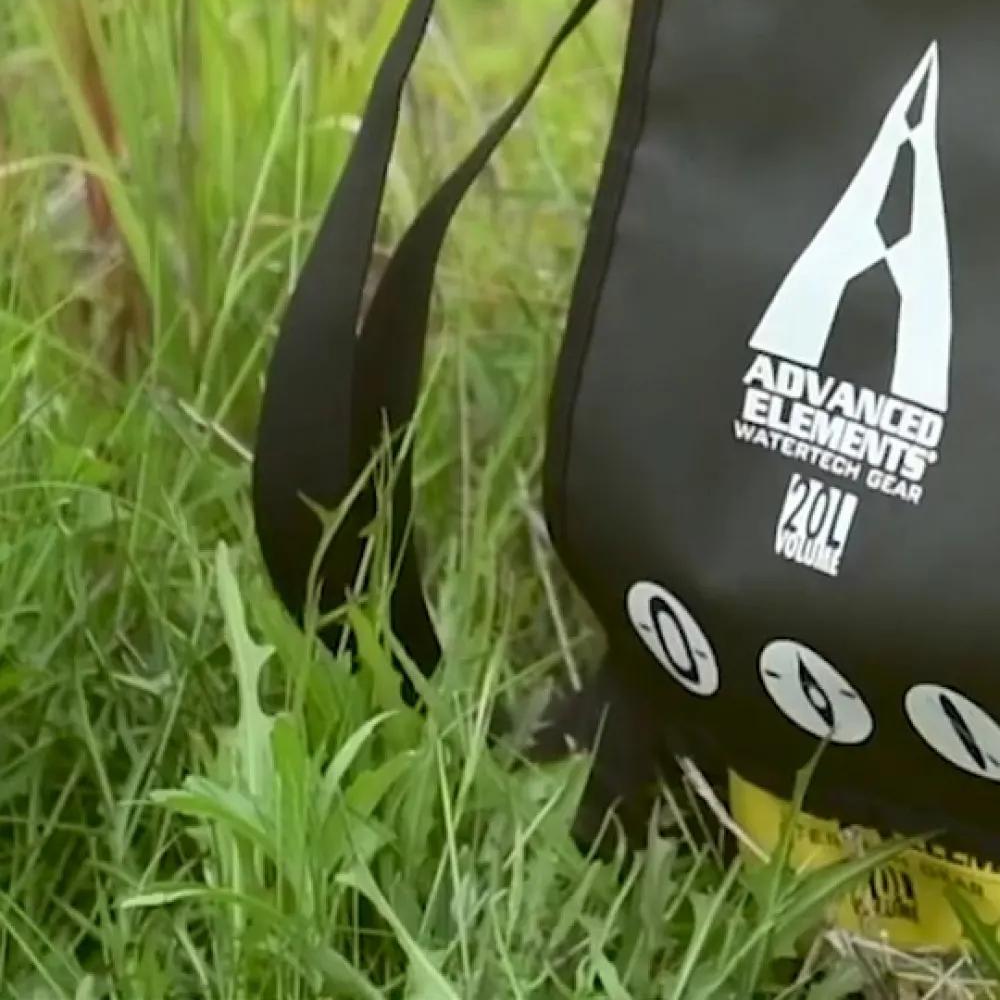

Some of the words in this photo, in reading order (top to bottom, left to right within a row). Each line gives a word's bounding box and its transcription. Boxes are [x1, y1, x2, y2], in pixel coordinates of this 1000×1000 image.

[742, 353, 945, 448] ADVANCED
[743, 387, 927, 482] ELEMENTS
[733, 419, 862, 480] WATERTECH
[865, 468, 923, 505] GEAR
[775, 531, 842, 577] VOLUME
